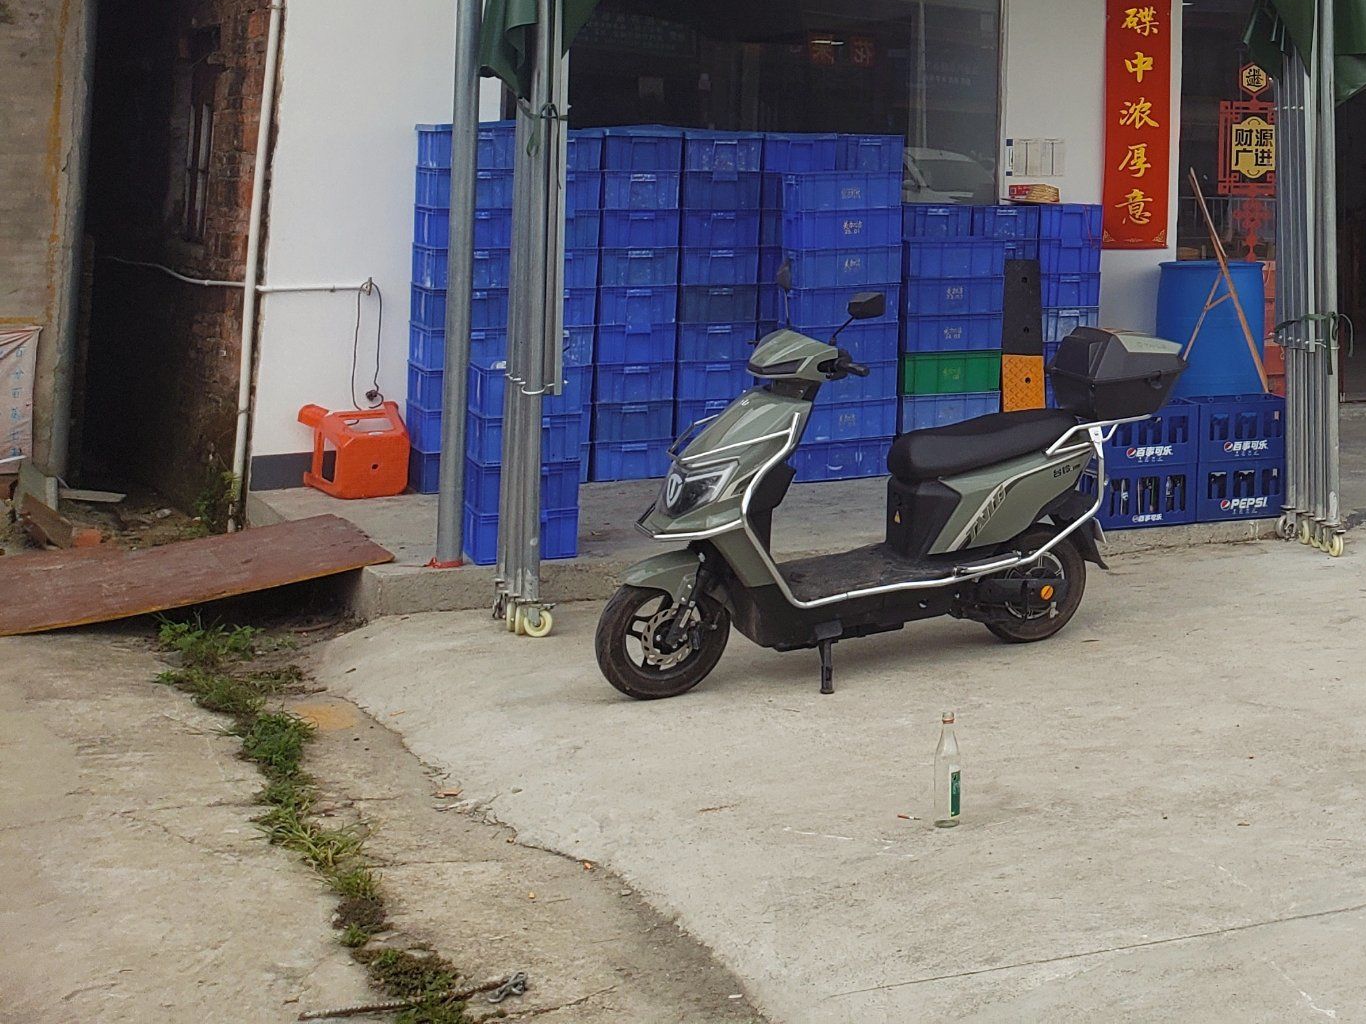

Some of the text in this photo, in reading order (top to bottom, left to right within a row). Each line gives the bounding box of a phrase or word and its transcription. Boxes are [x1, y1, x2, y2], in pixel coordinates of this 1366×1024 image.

[1235, 129, 1273, 147] 财源
[1235, 148, 1273, 167] 广进
[1233, 440, 1269, 451] 百事可乐
[1136, 446, 1173, 457] 百事可乐
[1231, 497, 1268, 509] PEPSI
[1138, 514, 1163, 522] 百事可乐
